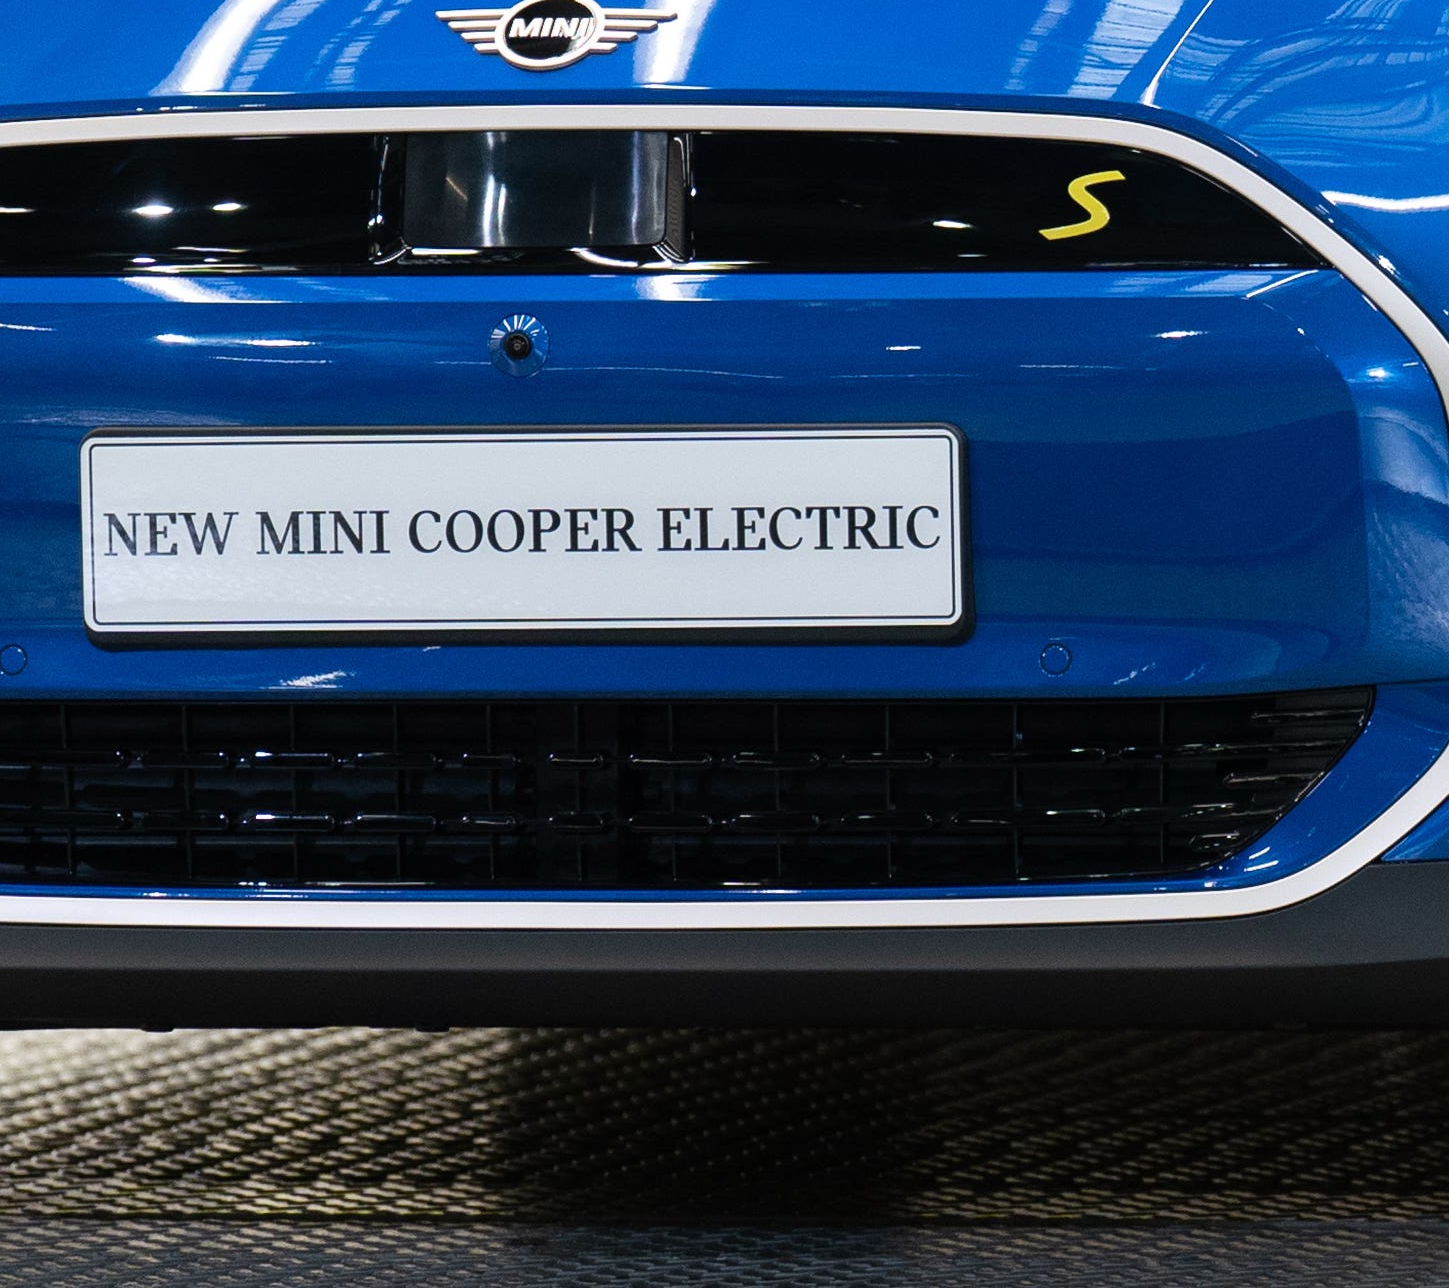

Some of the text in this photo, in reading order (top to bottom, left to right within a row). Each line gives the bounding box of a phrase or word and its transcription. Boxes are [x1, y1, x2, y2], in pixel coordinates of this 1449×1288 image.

[509, 17, 593, 38] MINI
[1040, 171, 1124, 240] S
[104, 506, 940, 555] NEW MINI COOPER ELECTRIC
